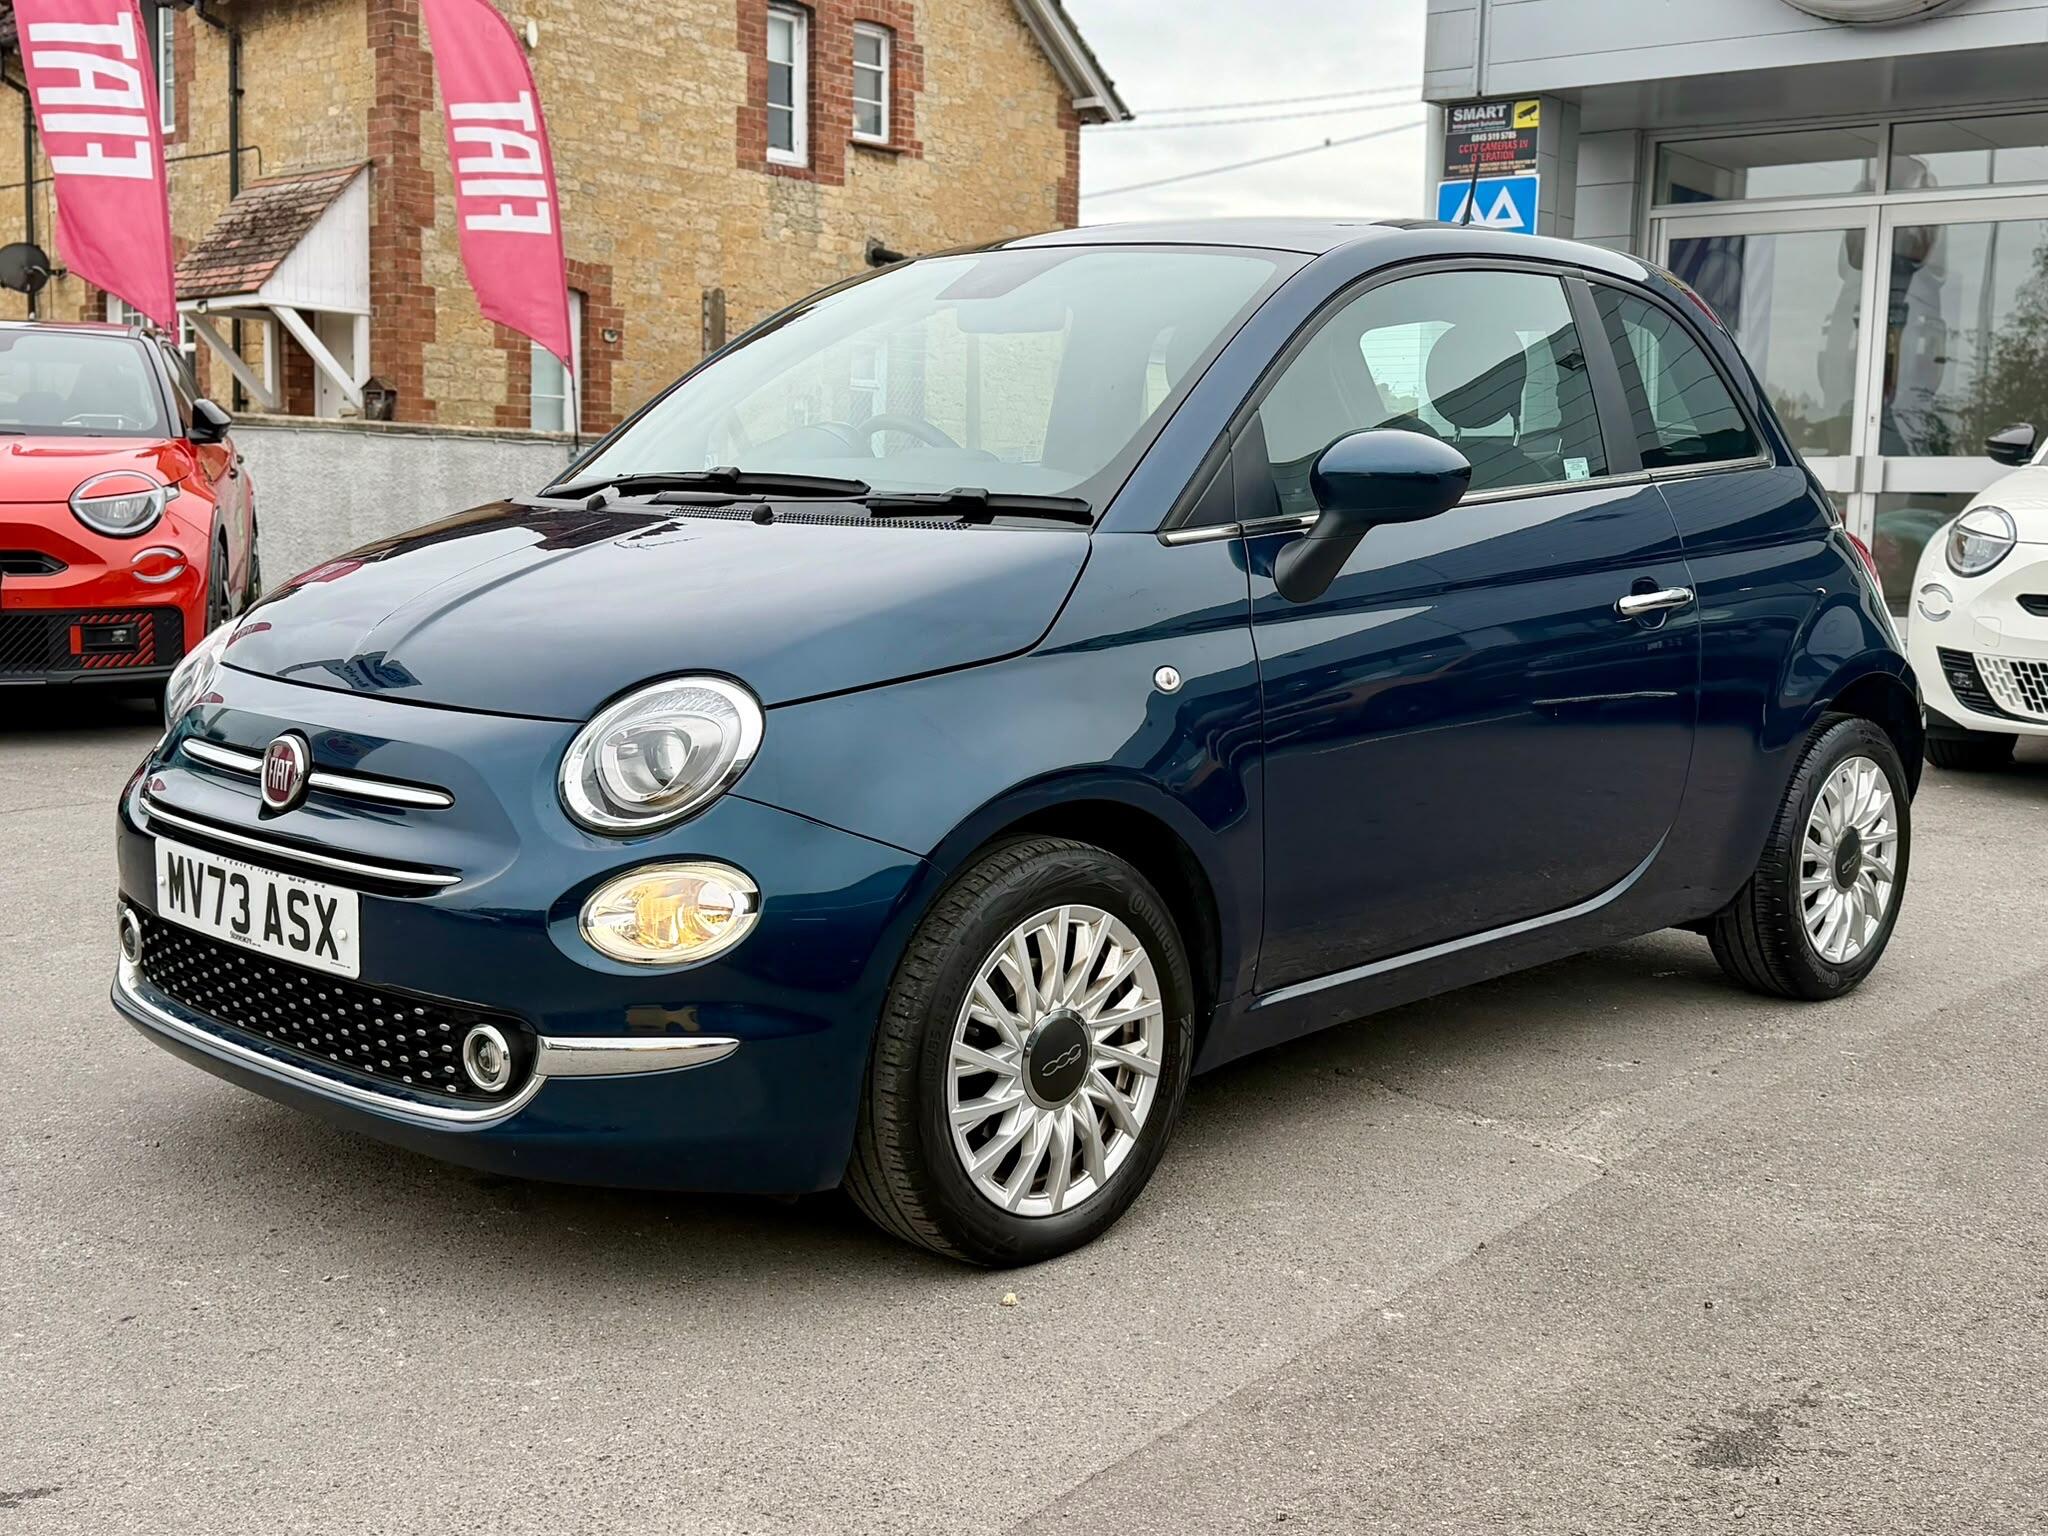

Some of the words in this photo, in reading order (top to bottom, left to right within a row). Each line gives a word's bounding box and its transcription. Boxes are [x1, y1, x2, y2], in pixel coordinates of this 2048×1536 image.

[1453, 105, 1506, 121] SMART
[1459, 143, 1479, 154] CCTV
[1480, 140, 1518, 152] CAMERAS
[1471, 151, 1515, 162] OERATION
[267, 757, 293, 791] FIAT
[167, 852, 251, 935] MV73
[263, 882, 339, 961] ASX
